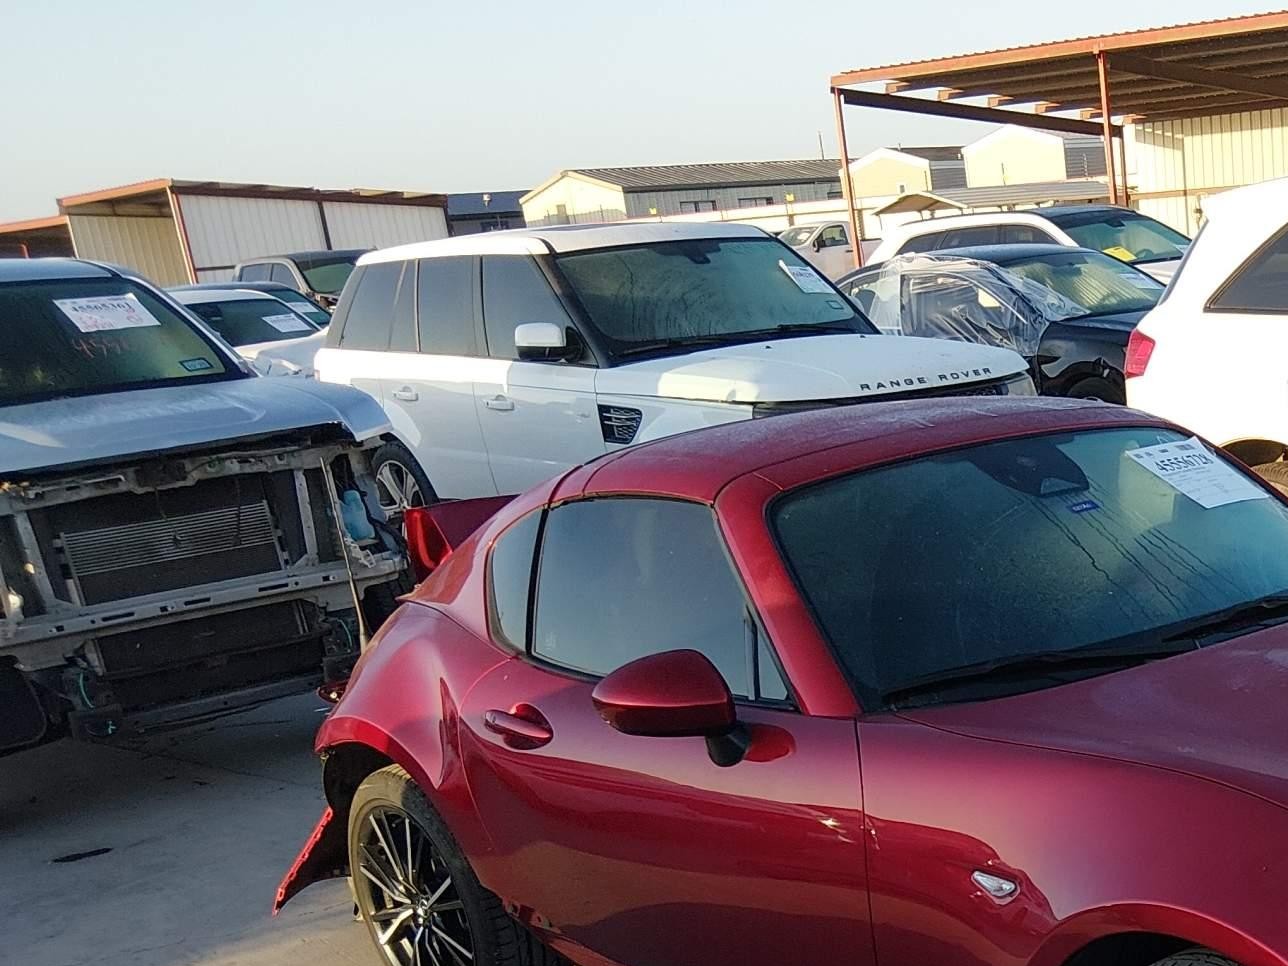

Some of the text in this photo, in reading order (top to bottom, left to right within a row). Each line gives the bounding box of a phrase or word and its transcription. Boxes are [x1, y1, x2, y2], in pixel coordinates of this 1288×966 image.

[859, 367, 992, 391] RANGE ROVER
[1155, 453, 1214, 472] 45556728
